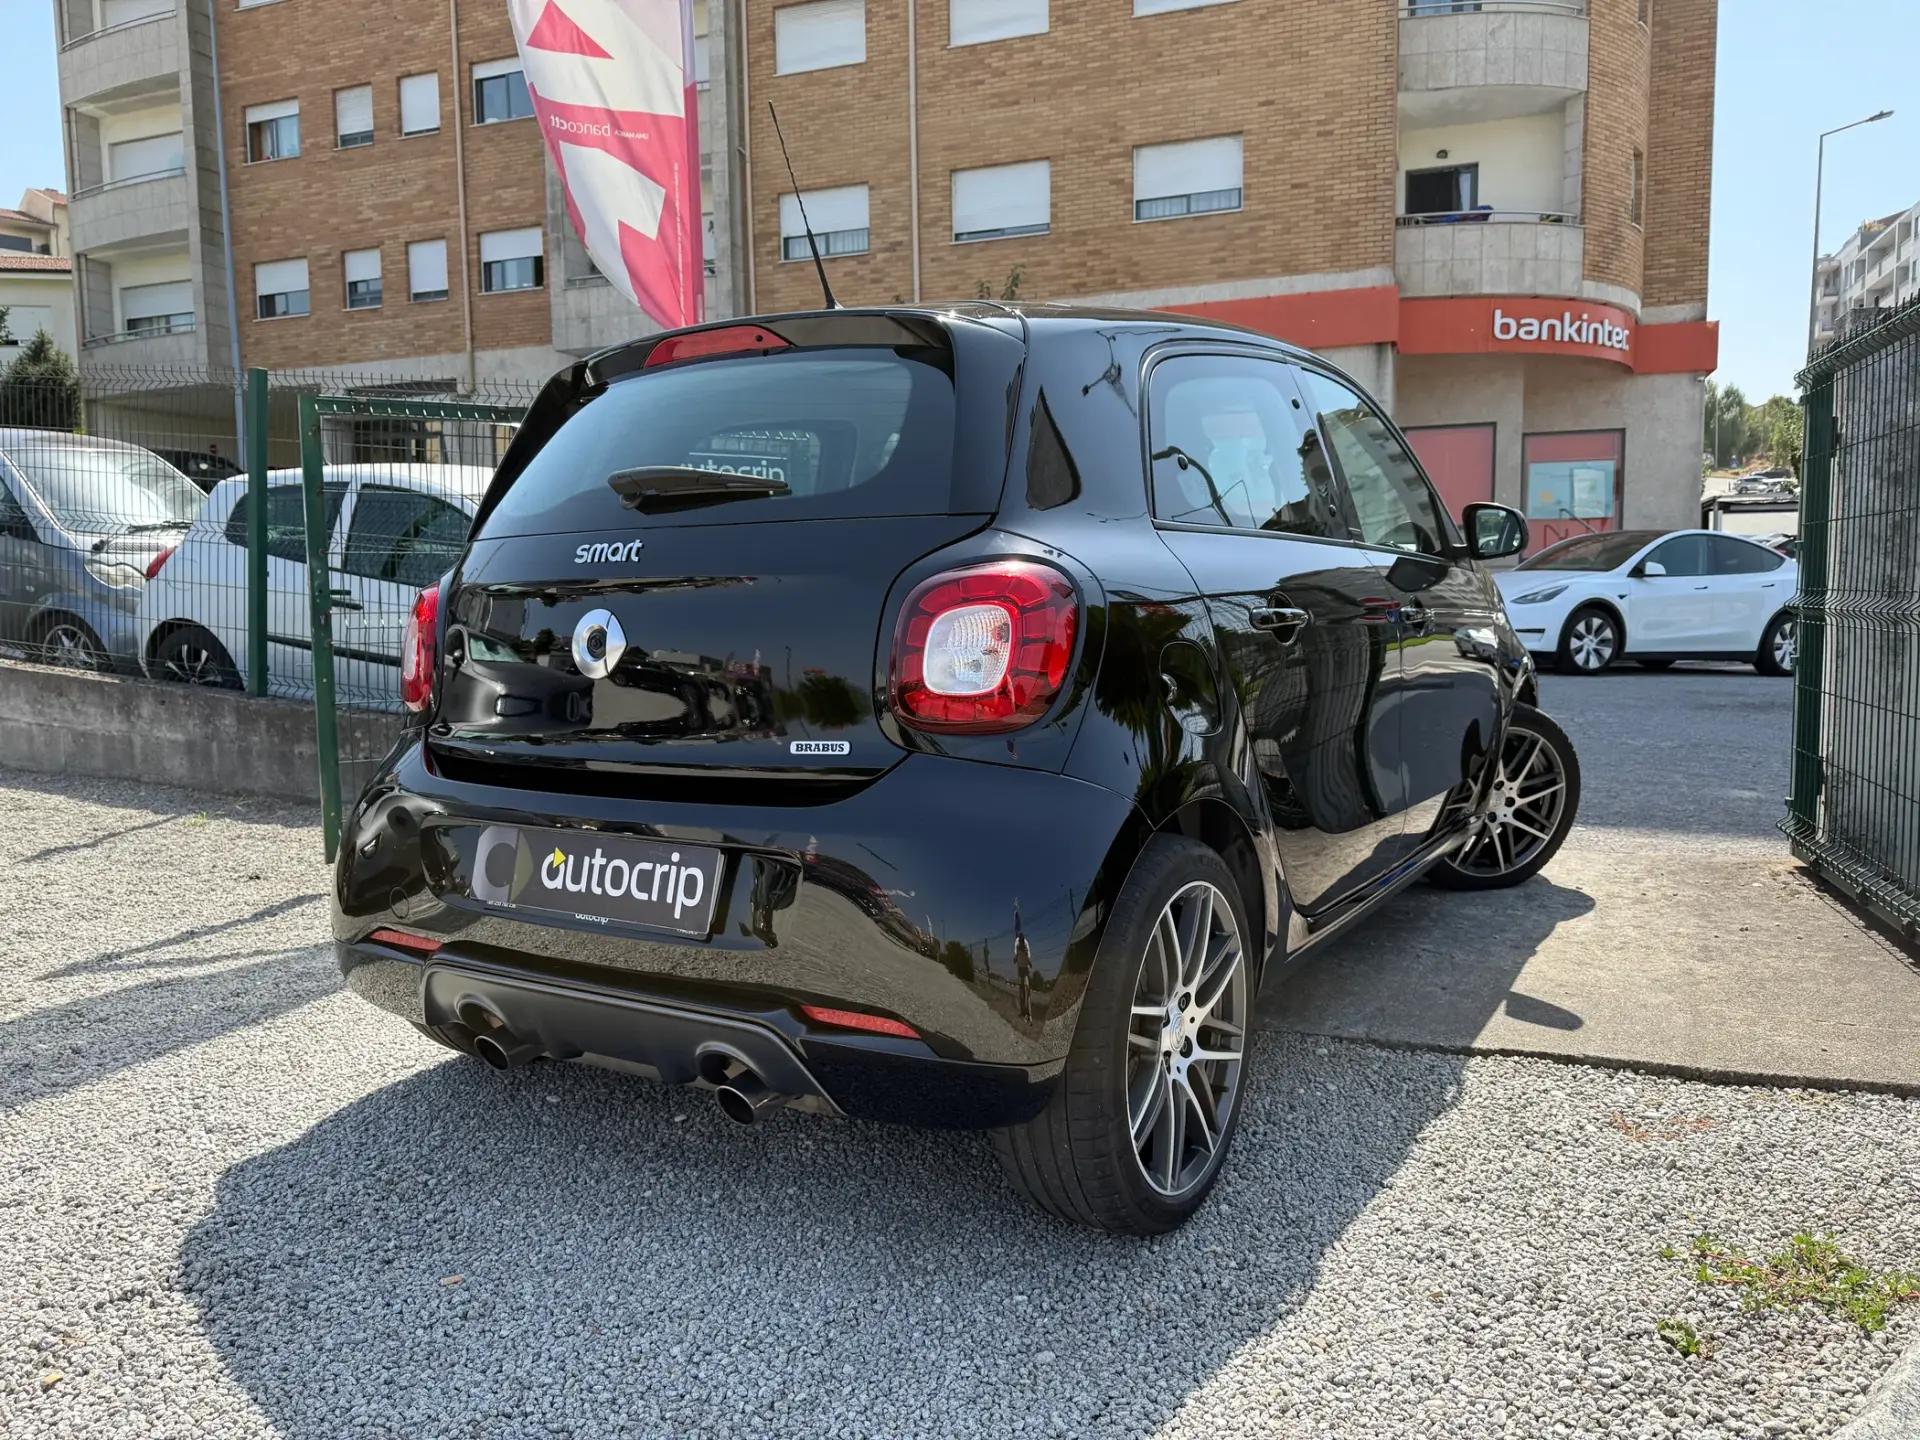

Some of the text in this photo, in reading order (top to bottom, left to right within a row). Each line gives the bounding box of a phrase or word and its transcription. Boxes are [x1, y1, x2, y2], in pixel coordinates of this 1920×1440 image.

[574, 539, 643, 564] smart
[795, 743, 845, 753] BRABUS
[540, 847, 704, 919] autocrip
